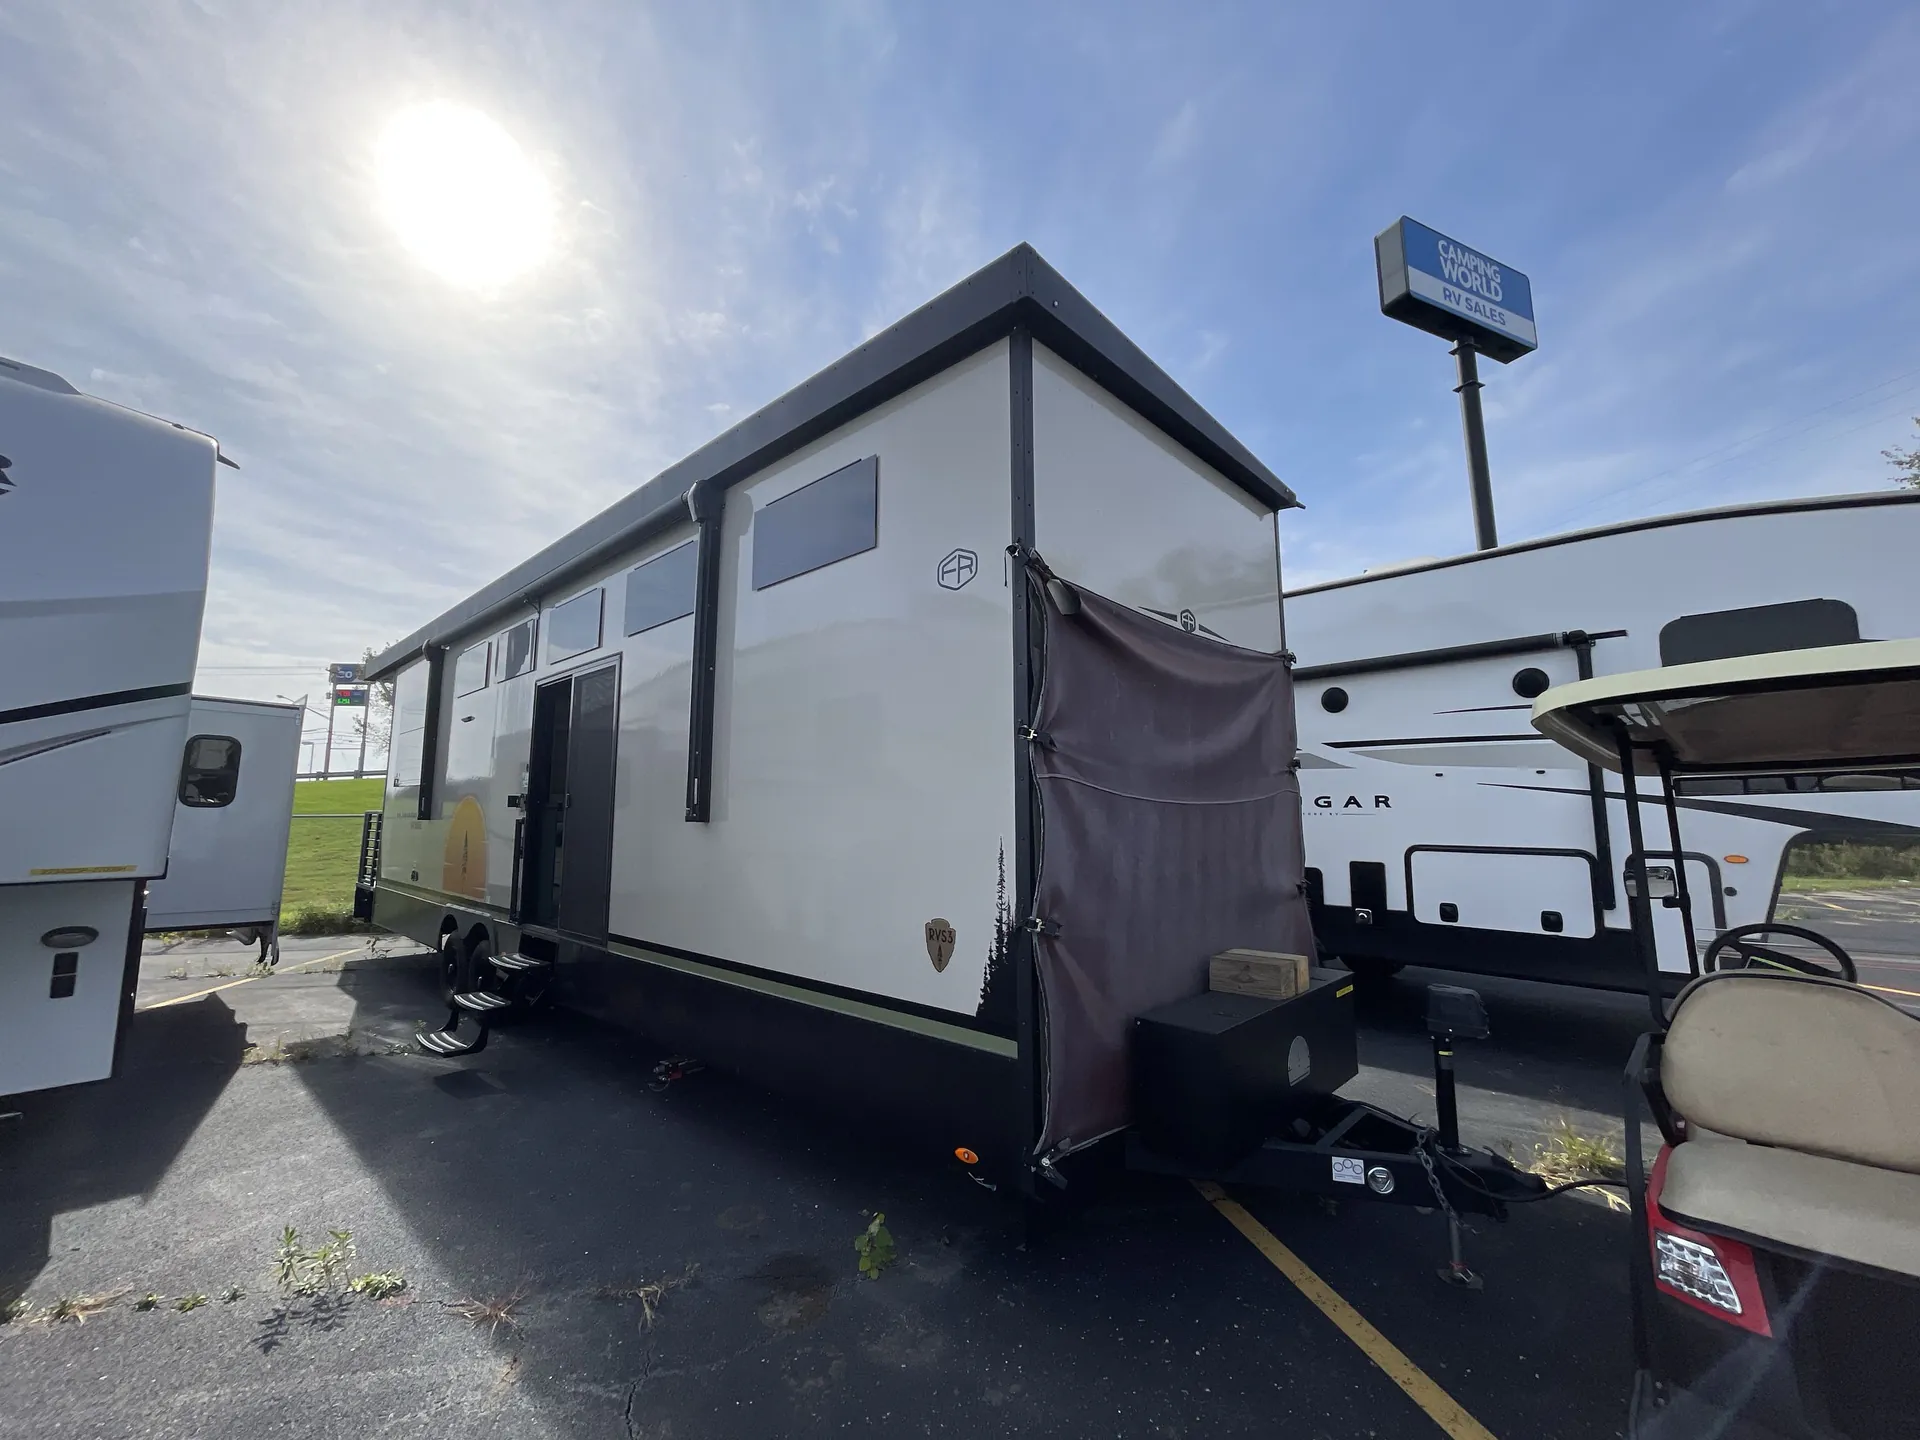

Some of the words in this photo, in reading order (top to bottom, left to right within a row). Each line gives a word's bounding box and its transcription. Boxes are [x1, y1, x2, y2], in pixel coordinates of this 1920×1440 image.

[1438, 240, 1501, 283] CAMPING
[1440, 256, 1502, 301] WORLD
[1443, 286, 1462, 306] RV
[1465, 297, 1506, 325] SALES
[1300, 795, 1392, 808] GAR
